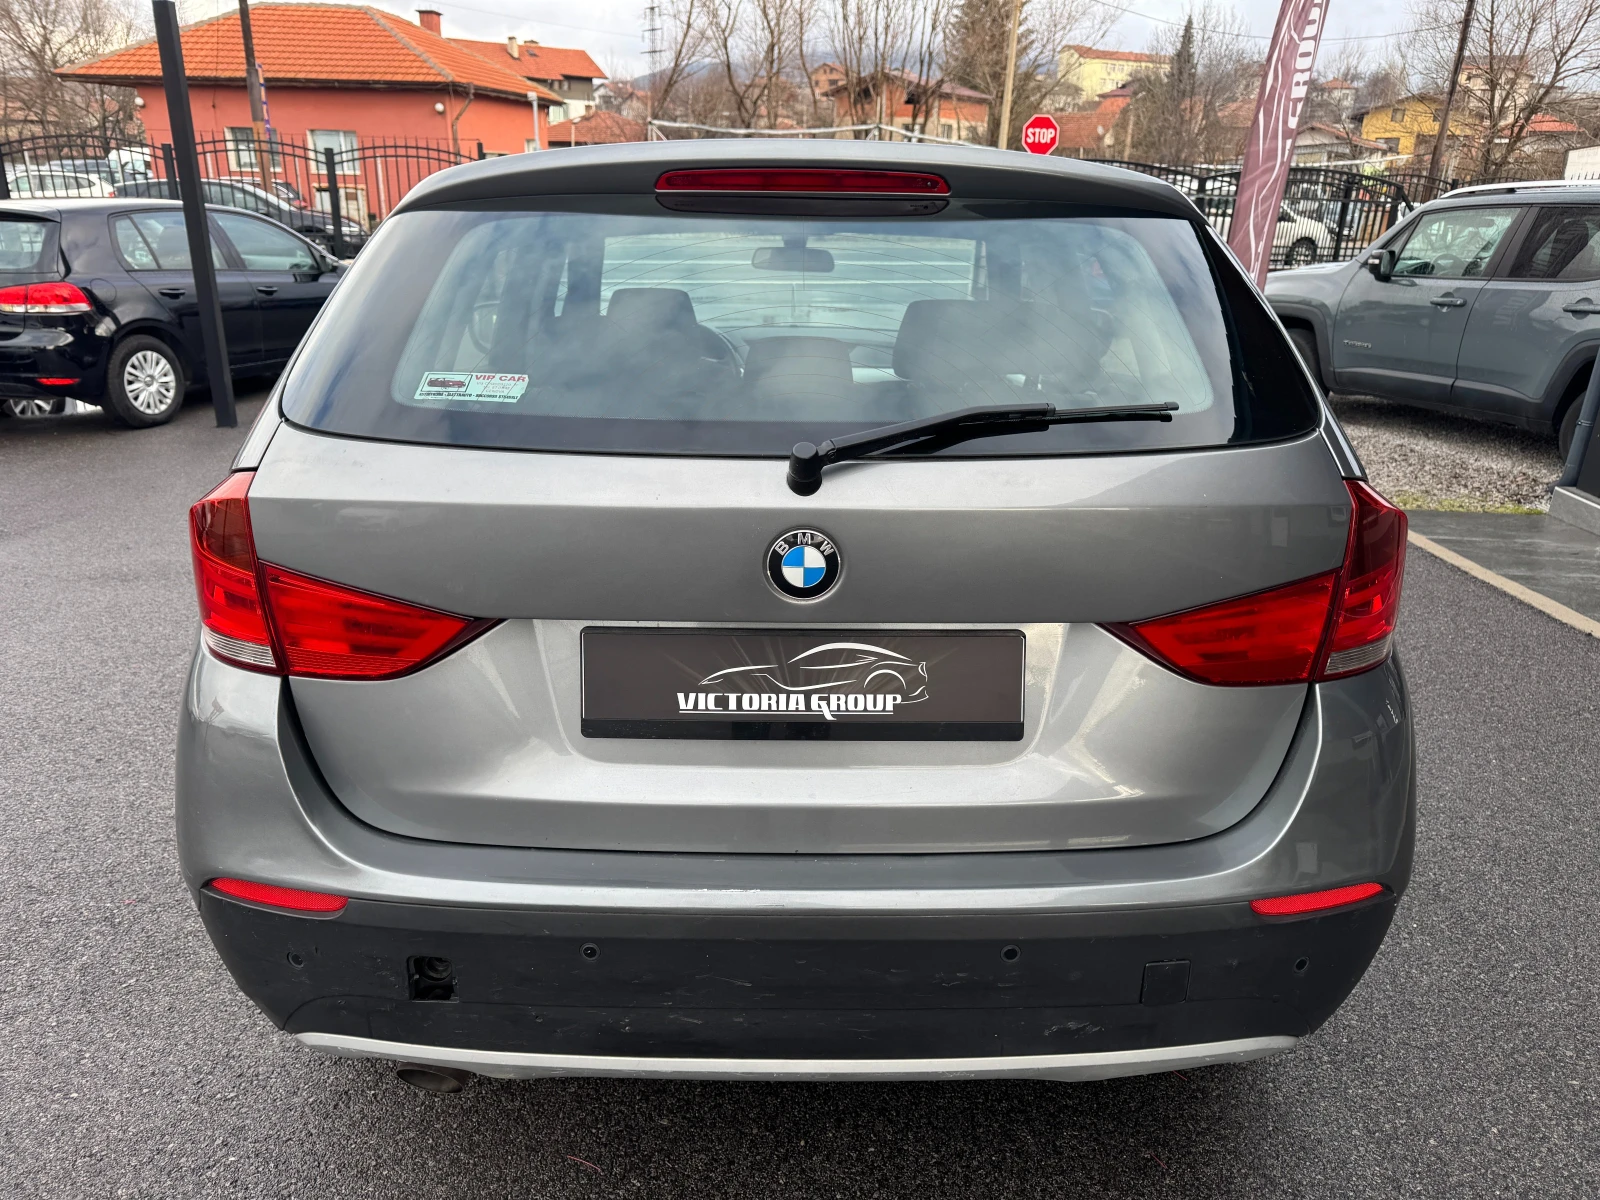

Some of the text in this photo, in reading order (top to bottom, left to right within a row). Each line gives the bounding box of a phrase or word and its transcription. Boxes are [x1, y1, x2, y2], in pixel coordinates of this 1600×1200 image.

[1287, 0, 1321, 129] GROU
[1026, 128, 1055, 143] STOP
[775, 532, 834, 556] BMW
[677, 692, 902, 720] VICTORIA GROUP
